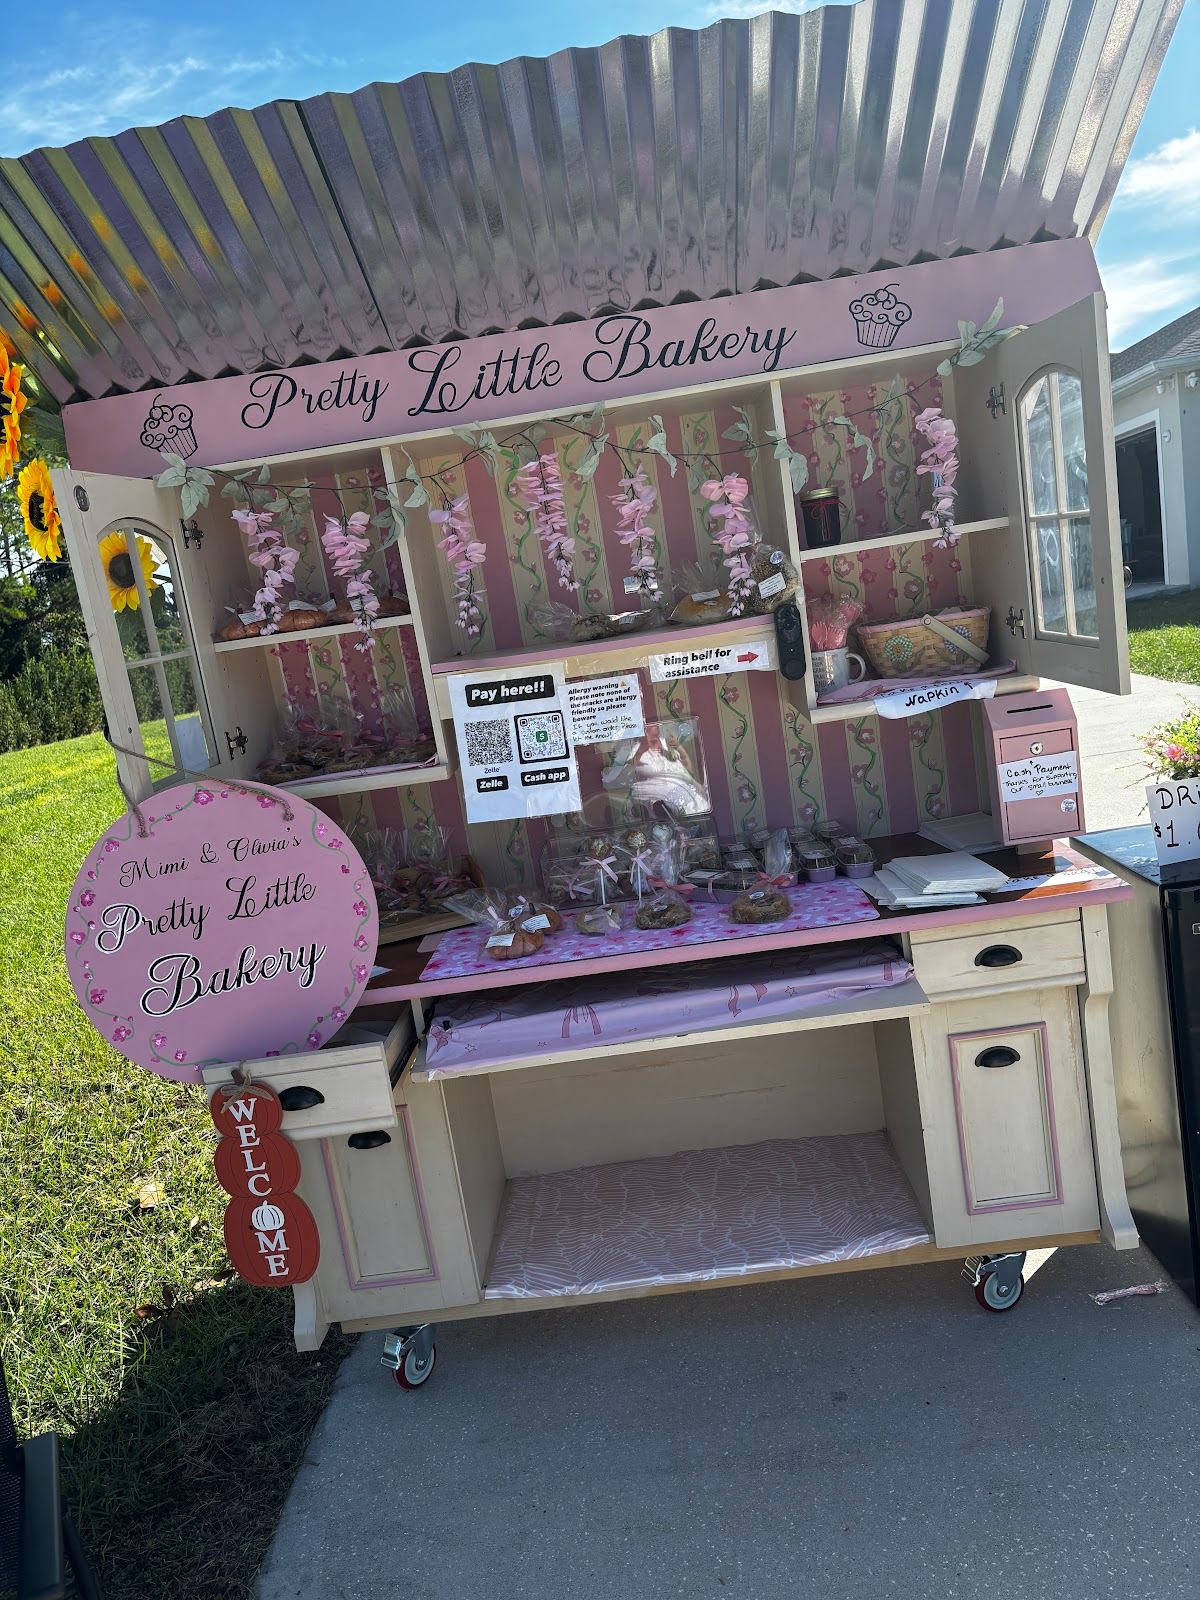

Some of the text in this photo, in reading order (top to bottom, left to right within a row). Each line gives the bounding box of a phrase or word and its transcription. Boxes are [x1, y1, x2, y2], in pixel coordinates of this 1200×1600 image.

[241, 314, 797, 430] Pretty Little Bakery
[663, 648, 732, 666] Ring bell for
[665, 663, 720, 678] assistance
[471, 680, 545, 702] Pay here!!
[568, 683, 619, 695] Allergy warning
[569, 694, 590, 702] Please
[582, 699, 603, 707] snacks
[614, 694, 637, 702] allergy
[571, 707, 597, 716] friendly
[606, 703, 627, 711] please
[572, 715, 597, 723] beware
[484, 767, 501, 775] Zelle
[524, 771, 567, 783] Cash app
[1006, 763, 1072, 778] Cash Payment
[480, 779, 503, 789] Zelle
[119, 858, 189, 888] Mimi
[200, 842, 219, 864] &
[95, 872, 317, 954] Pretty Little
[140, 943, 326, 1017] Bakery
